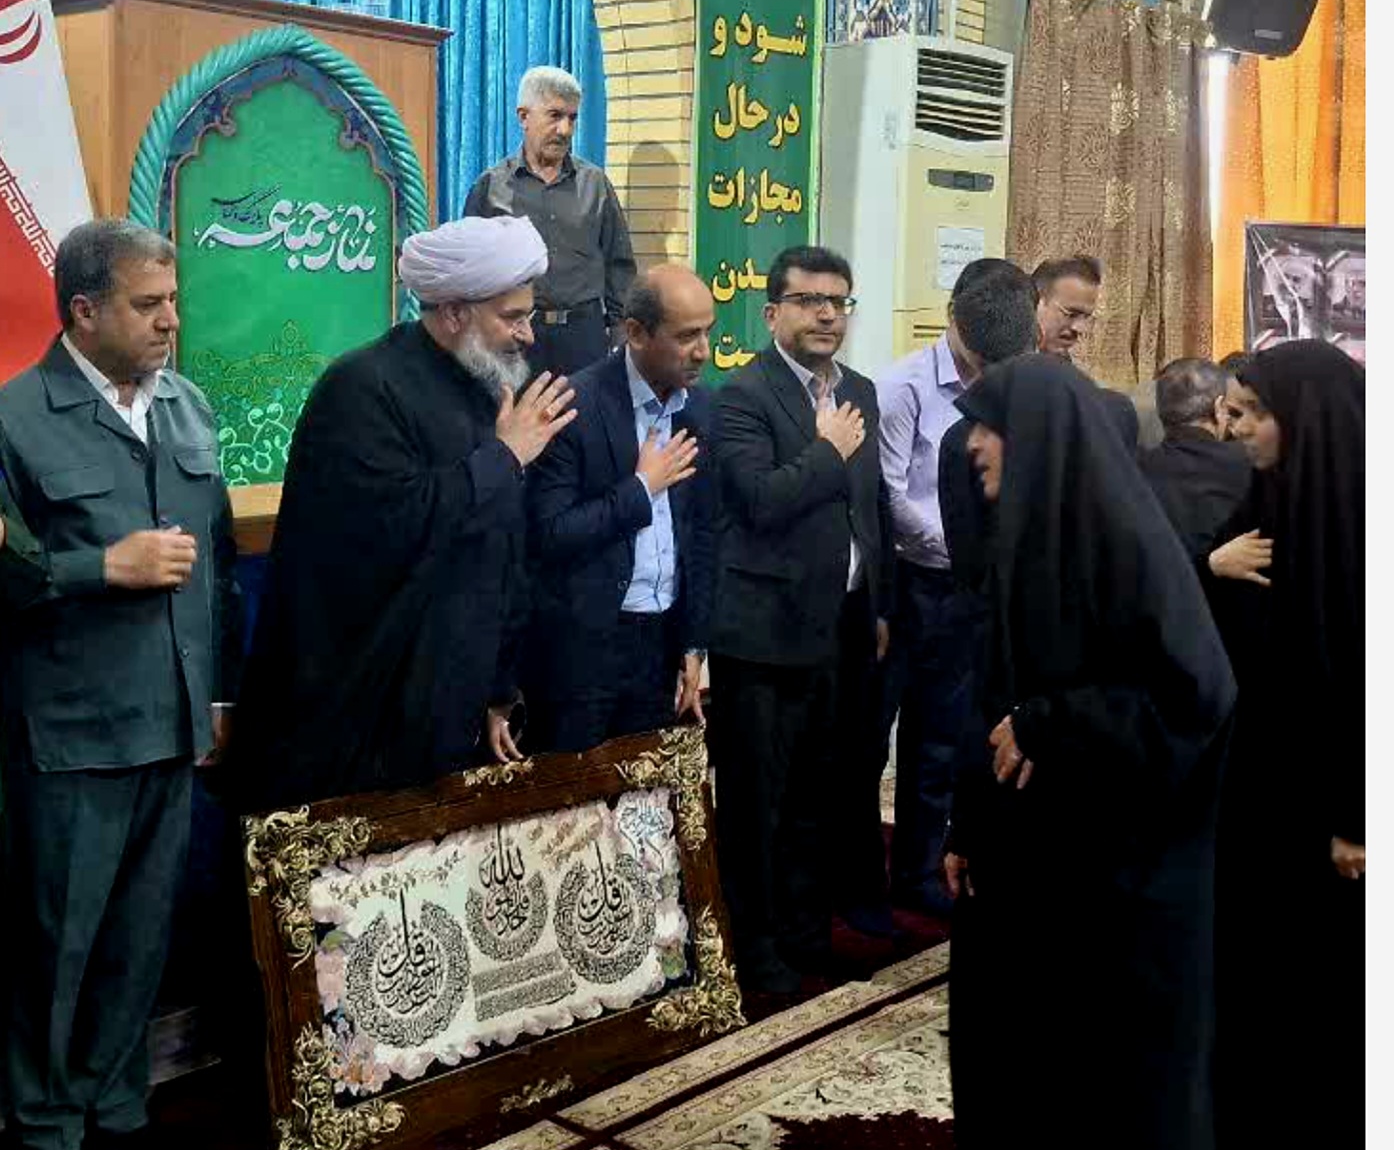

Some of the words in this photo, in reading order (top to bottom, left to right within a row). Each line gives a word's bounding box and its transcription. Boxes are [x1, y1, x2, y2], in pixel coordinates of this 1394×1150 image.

[709, 16, 727, 57] و
[735, 11, 807, 64] شود
[707, 166, 802, 226] مجازات
[196, 199, 335, 270] جمعه
[303, 204, 377, 273] نماز
[712, 257, 768, 302] دن
